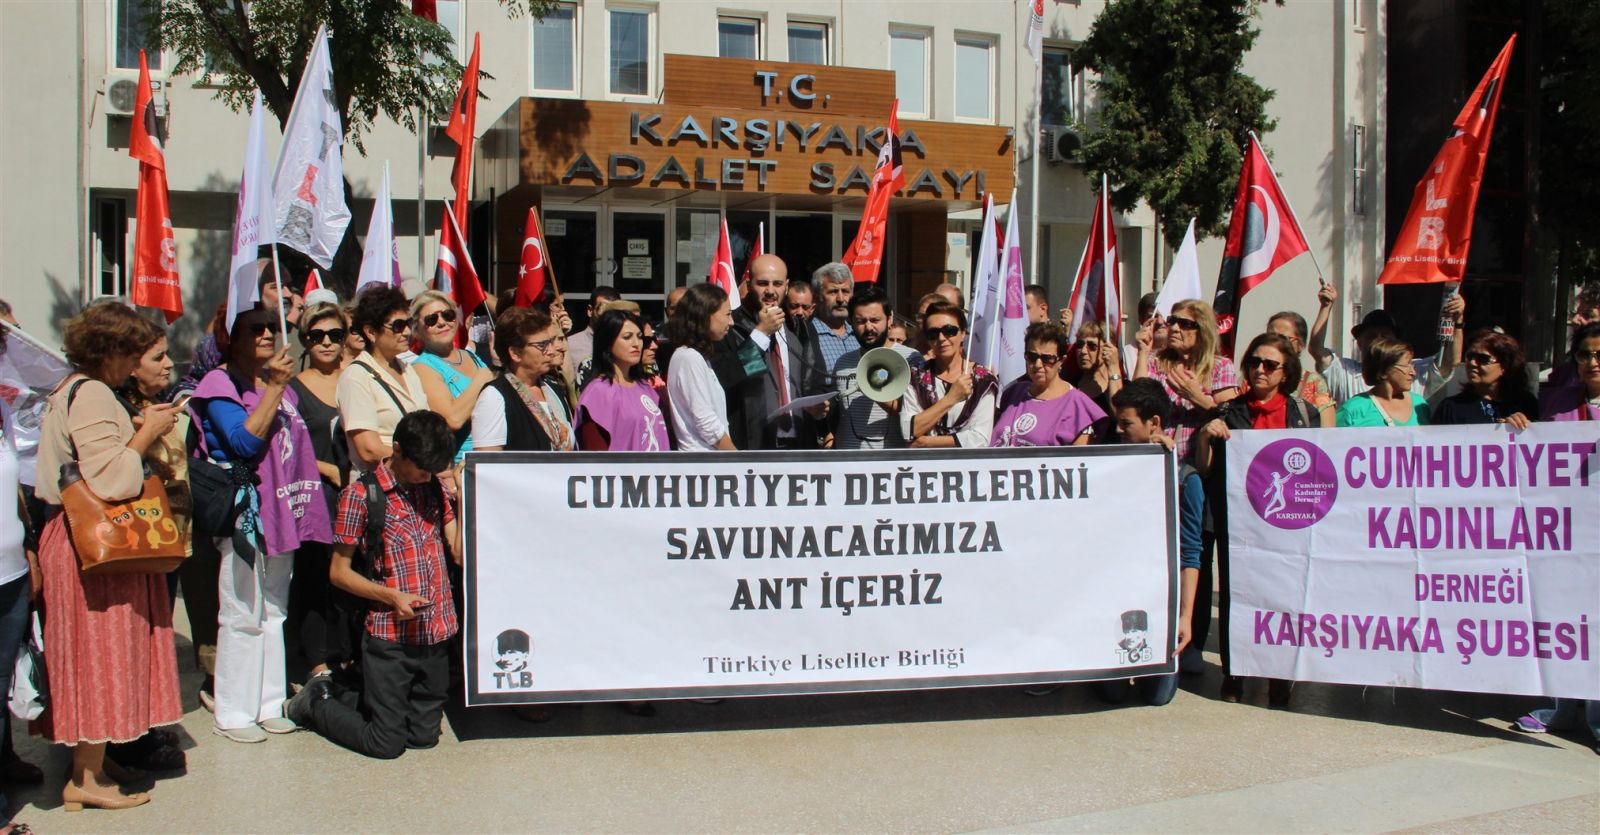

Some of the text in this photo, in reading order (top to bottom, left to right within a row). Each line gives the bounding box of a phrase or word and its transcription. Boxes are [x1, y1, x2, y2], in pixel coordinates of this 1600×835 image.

[756, 71, 831, 100] T.C.
[630, 111, 927, 157] KARŞIYAKA
[563, 151, 985, 197] ADALET SAAYI
[1344, 433, 1597, 489] CUMHURİYET
[567, 462, 1089, 508] CUMHURİYET DEĞERLERİNİ
[1294, 482, 1335, 490] Cumhuriyet
[1276, 512, 1316, 520] KARŞIYAKA
[1368, 506, 1572, 551] KADINLARI
[667, 519, 1003, 560] SAVUNACAĞIMIZA
[730, 568, 943, 616] ANT İÇERİZ
[1414, 569, 1523, 604] DERNEĞİ
[1254, 611, 1589, 665] KARŞIYAKA ŞUBESİ
[493, 671, 533, 689] TLB
[703, 648, 965, 676] Türkiye Liseliler Birliği
